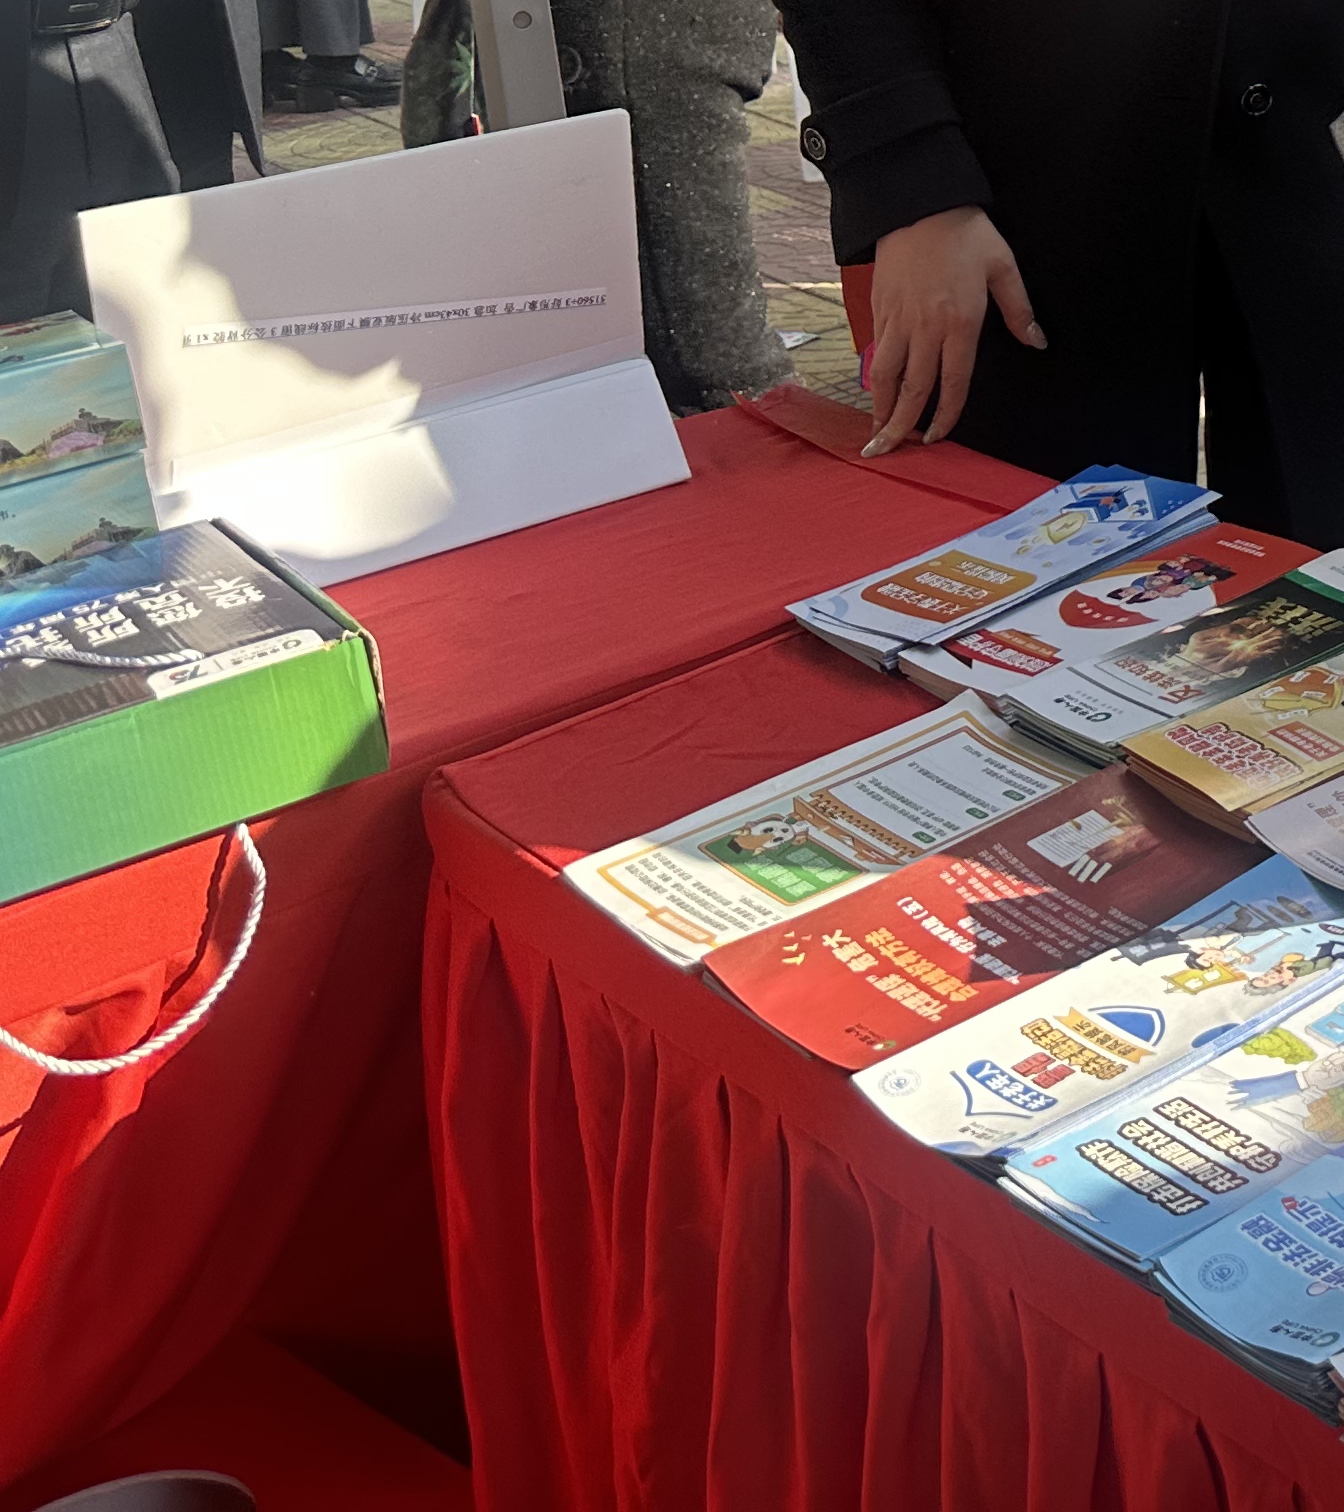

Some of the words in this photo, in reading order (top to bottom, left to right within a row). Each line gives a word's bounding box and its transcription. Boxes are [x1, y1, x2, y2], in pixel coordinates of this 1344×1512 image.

[1050, 696, 1091, 716] 中国人寿
[817, 927, 882, 974] 危害大
[860, 925, 981, 1004] 合理维权有方法
[1015, 1017, 1130, 1082] 非法金融活动
[967, 1061, 1053, 1109] 关于老年人
[1116, 1117, 1245, 1195] 共创和谐社会
[1153, 1096, 1284, 1173] 守护美好生活
[1074, 1136, 1205, 1217] 打击保险欺诈
[1268, 1322, 1315, 1343] 中国人寿
